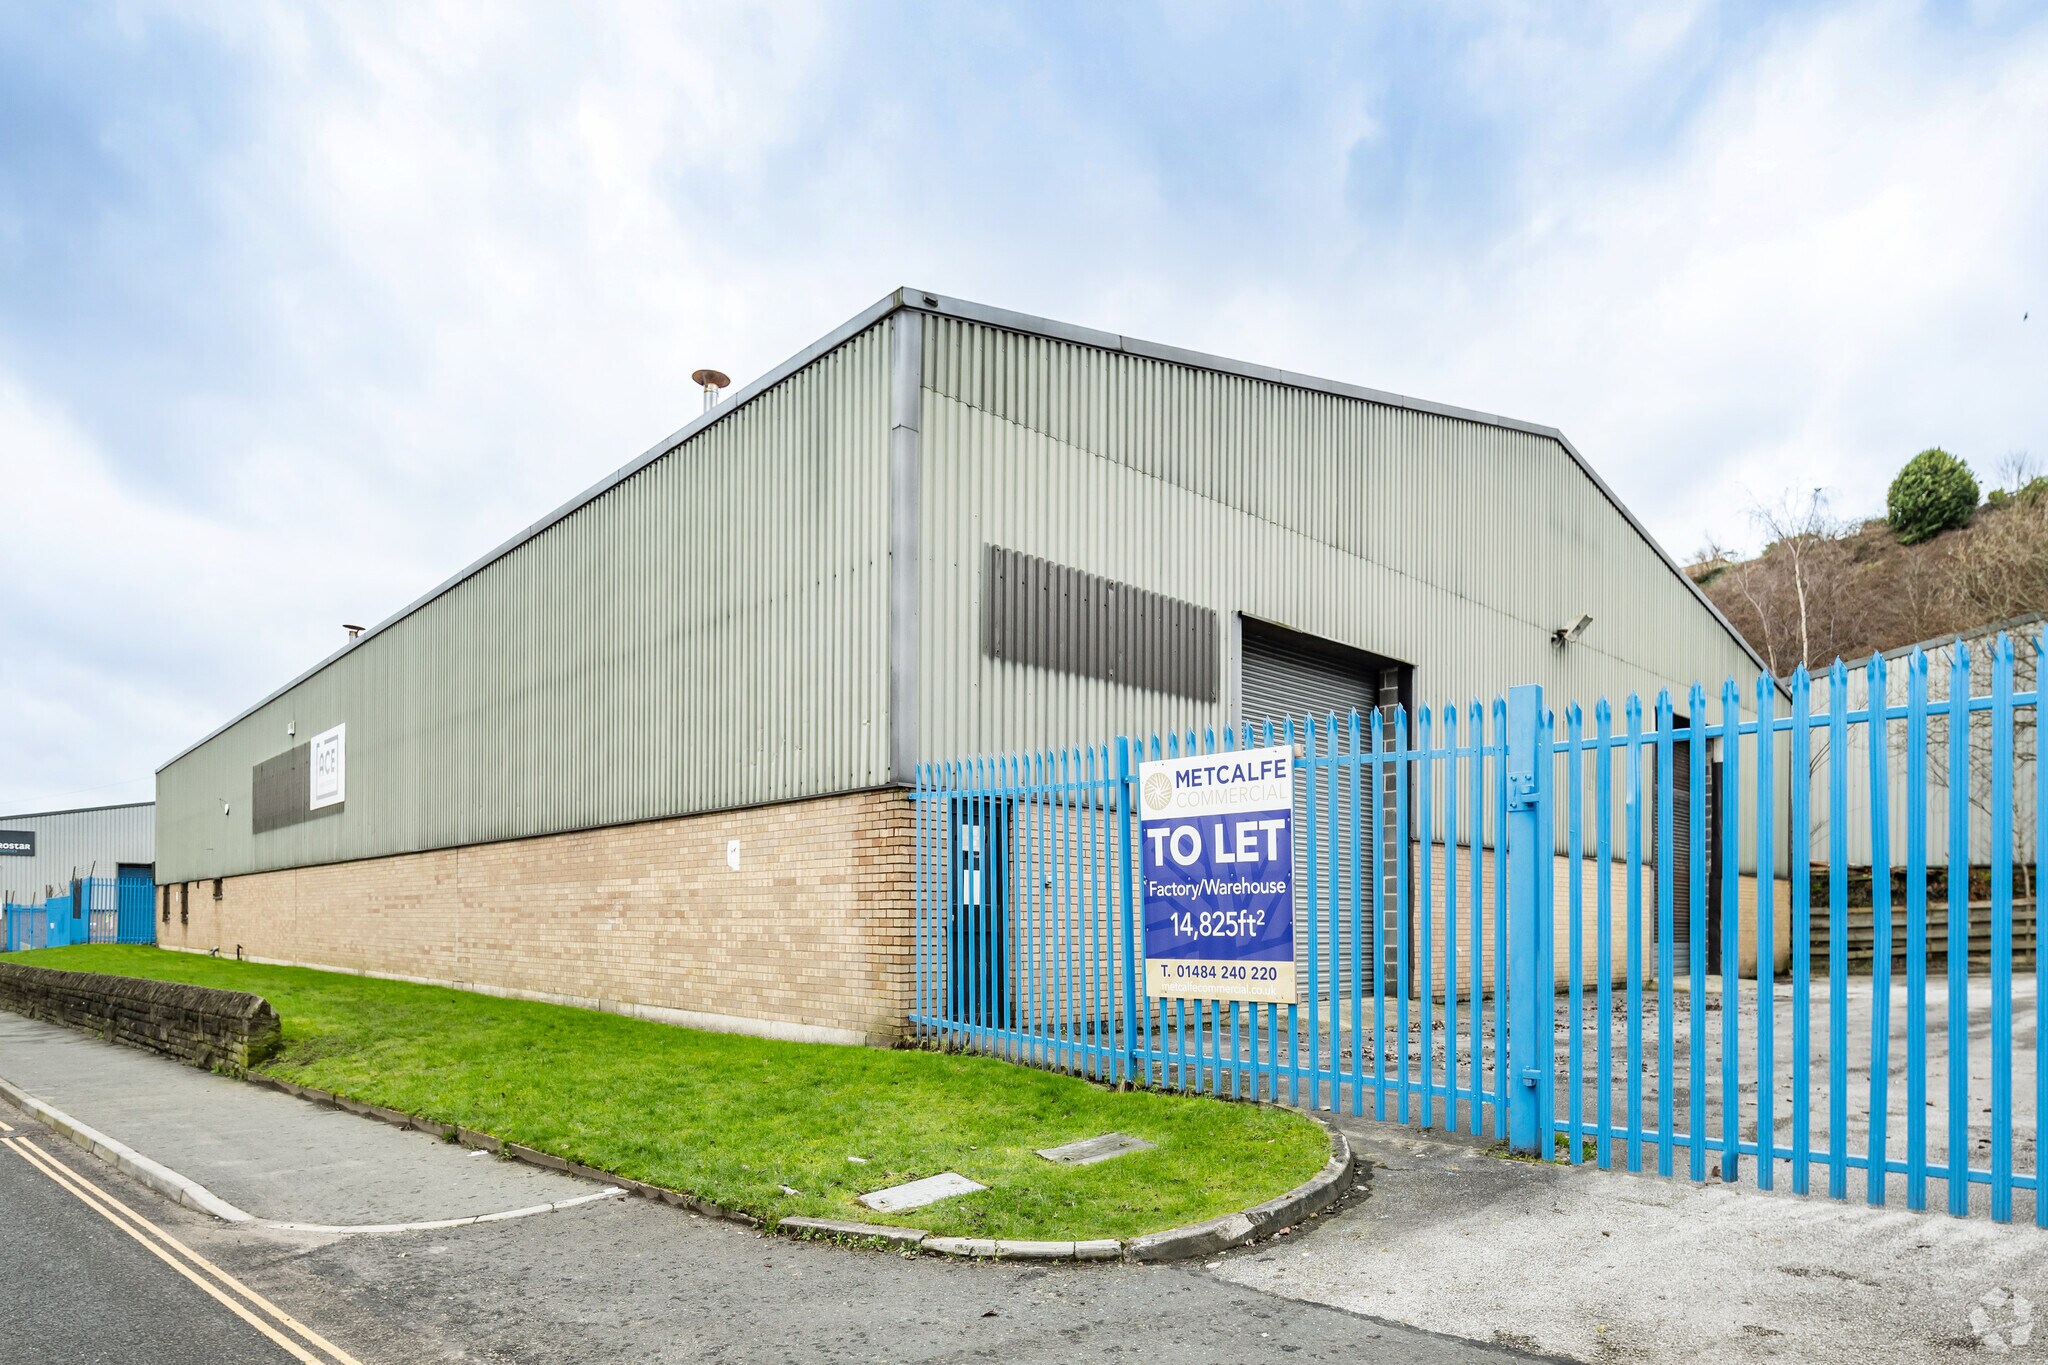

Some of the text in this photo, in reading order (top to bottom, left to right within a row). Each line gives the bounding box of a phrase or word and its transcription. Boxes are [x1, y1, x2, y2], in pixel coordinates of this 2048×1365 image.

[319, 748, 335, 777] ACE
[1175, 758, 1287, 789] METCALFE
[1176, 783, 1288, 809] COMMERCIAL
[1147, 819, 1286, 866] TO LET
[1149, 877, 1287, 901] Factory/Warehouse
[1160, 964, 1278, 981] T. 01484 240 220
[1161, 981, 1278, 996] metcalfecommercial.co.uk
